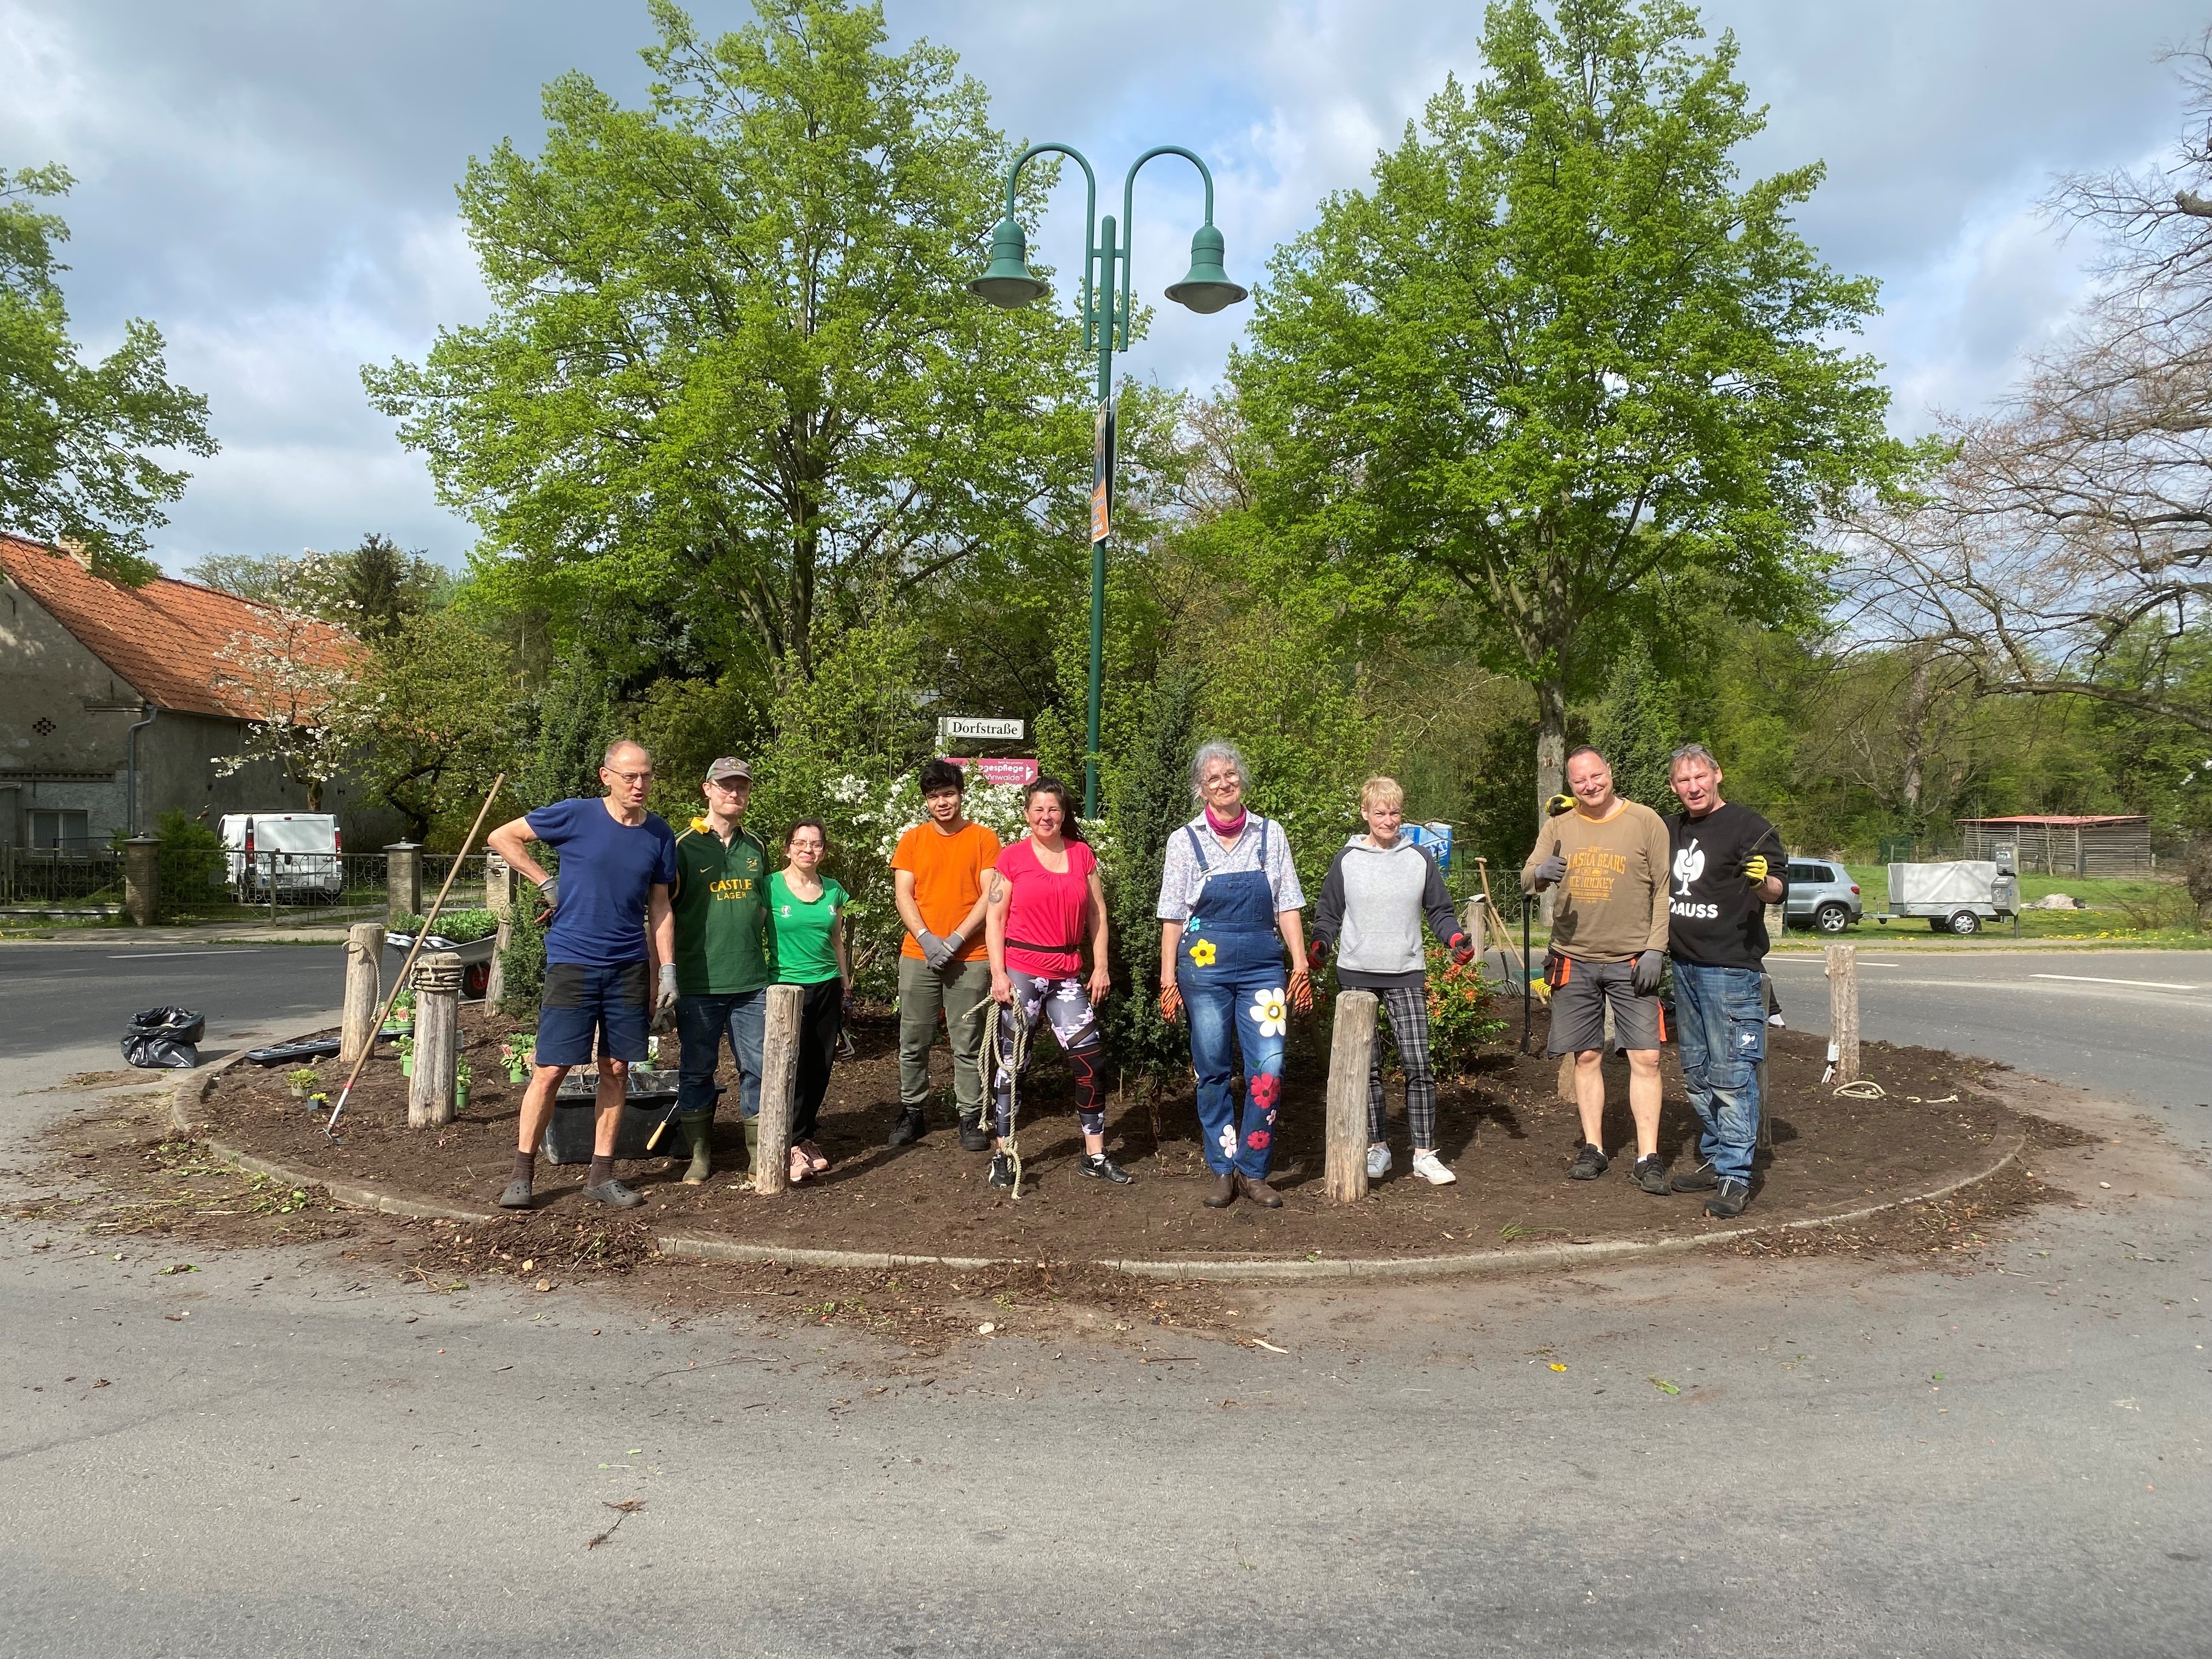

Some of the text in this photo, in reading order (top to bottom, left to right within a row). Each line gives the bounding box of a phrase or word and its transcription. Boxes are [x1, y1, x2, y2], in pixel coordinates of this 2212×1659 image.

[952, 721, 1018, 735] Dorfstraße
[978, 764, 1024, 773] agespflege
[1565, 852, 1627, 874] LASKA BEARS
[709, 879, 752, 893] CASTLE
[1570, 876, 1615, 889] ICE HOCKEY
[716, 891, 747, 901] LAGER
